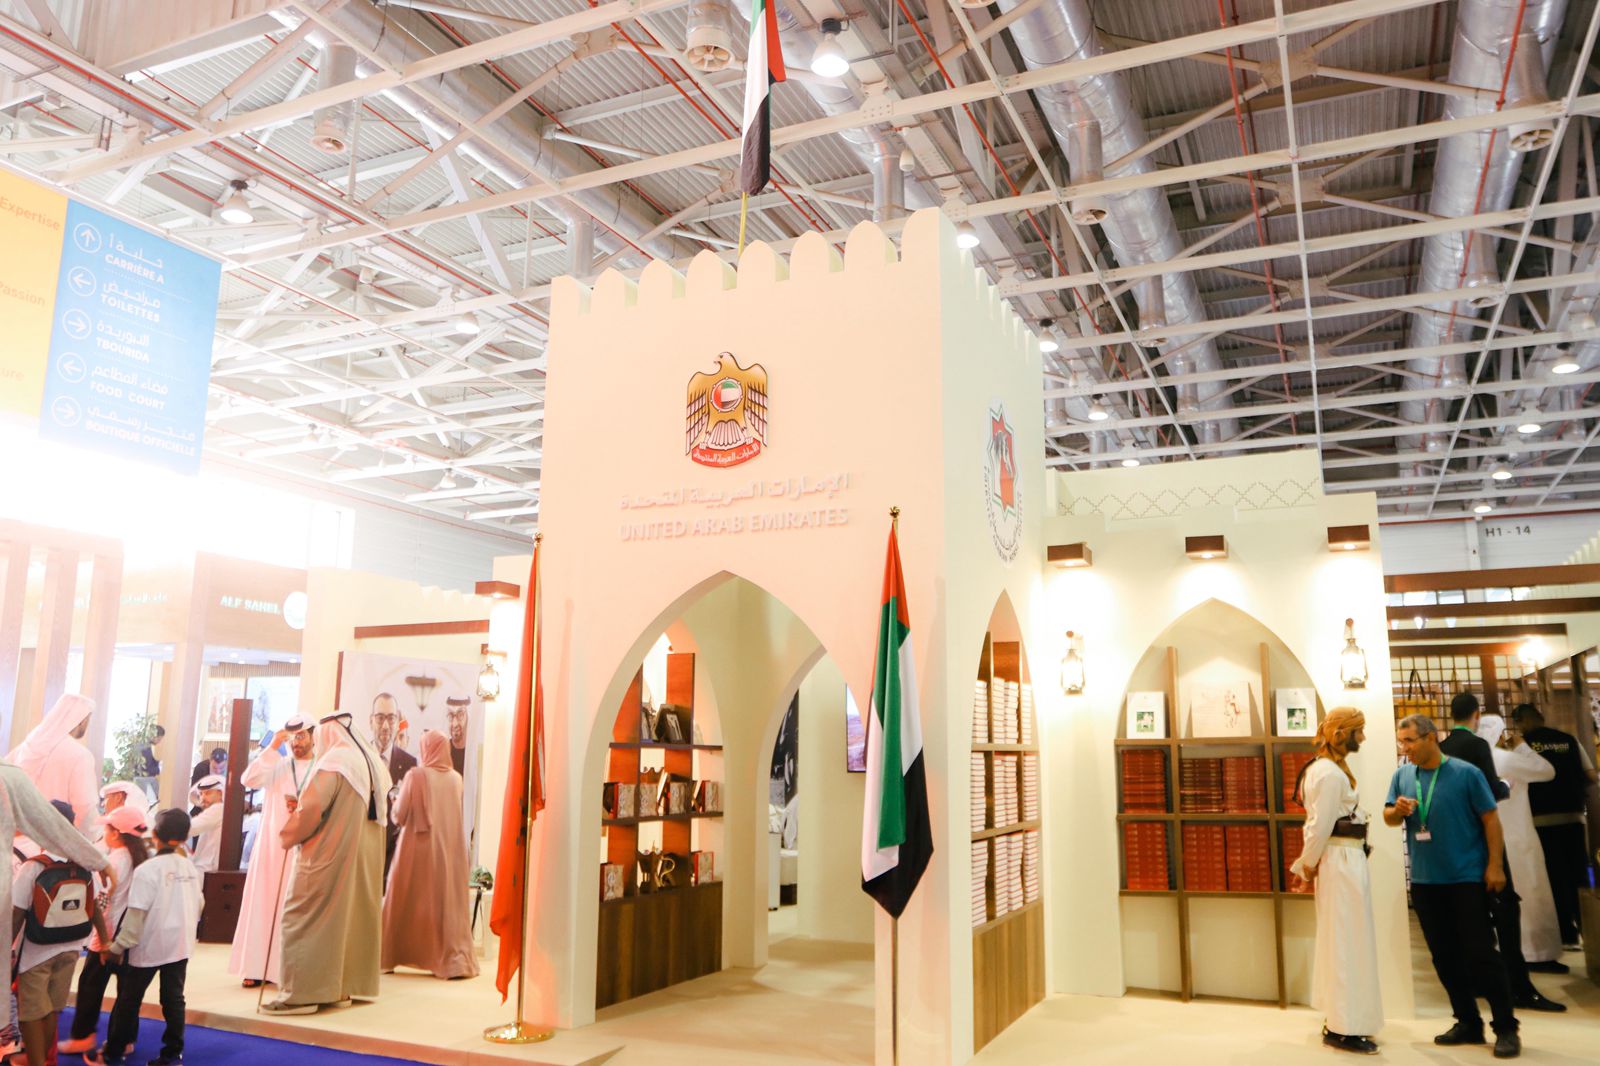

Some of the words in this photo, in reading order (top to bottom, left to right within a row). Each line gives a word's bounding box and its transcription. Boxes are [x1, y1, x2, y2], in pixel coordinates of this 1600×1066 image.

[0, 196, 60, 231] Expertise
[155, 274, 165, 285] A
[100, 293, 160, 323] TOILETTES
[96, 337, 150, 364] TBOURIDA
[89, 381, 123, 398] FOOD
[128, 390, 166, 411] COURT
[620, 520, 688, 542] UNITED
[692, 515, 745, 537] ARAB
[750, 508, 849, 533] EMIRATES
[1485, 527, 1502, 537] H1
[1515, 525, 1532, 536] 14
[220, 595, 241, 609] ALF
